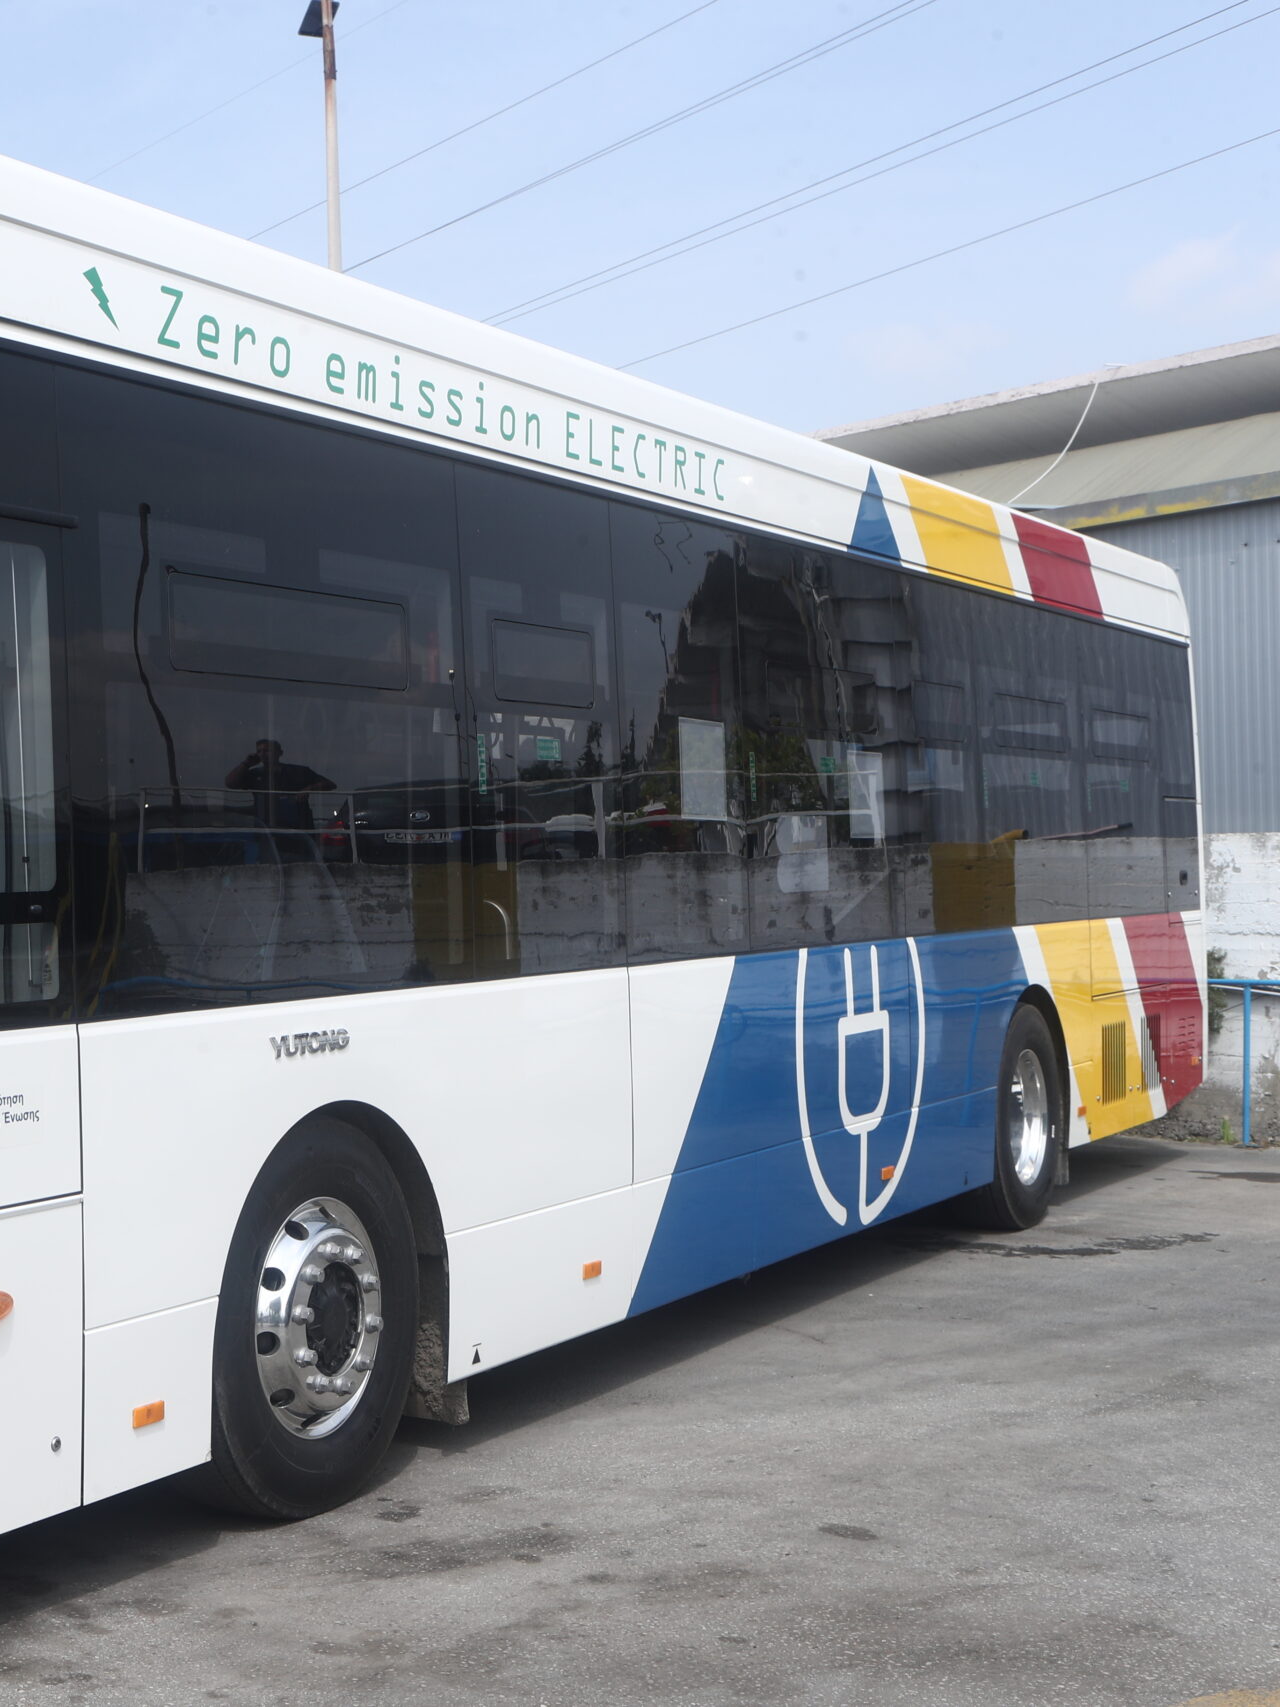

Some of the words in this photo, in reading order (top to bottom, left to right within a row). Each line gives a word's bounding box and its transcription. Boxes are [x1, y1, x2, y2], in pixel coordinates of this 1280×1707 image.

[156, 285, 291, 379] Zero
[324, 351, 541, 451] emission
[564, 410, 726, 502] ELECTRIC
[269, 1028, 350, 1060] YUTONG
[2, 1109, 40, 1124] Ένωσης
